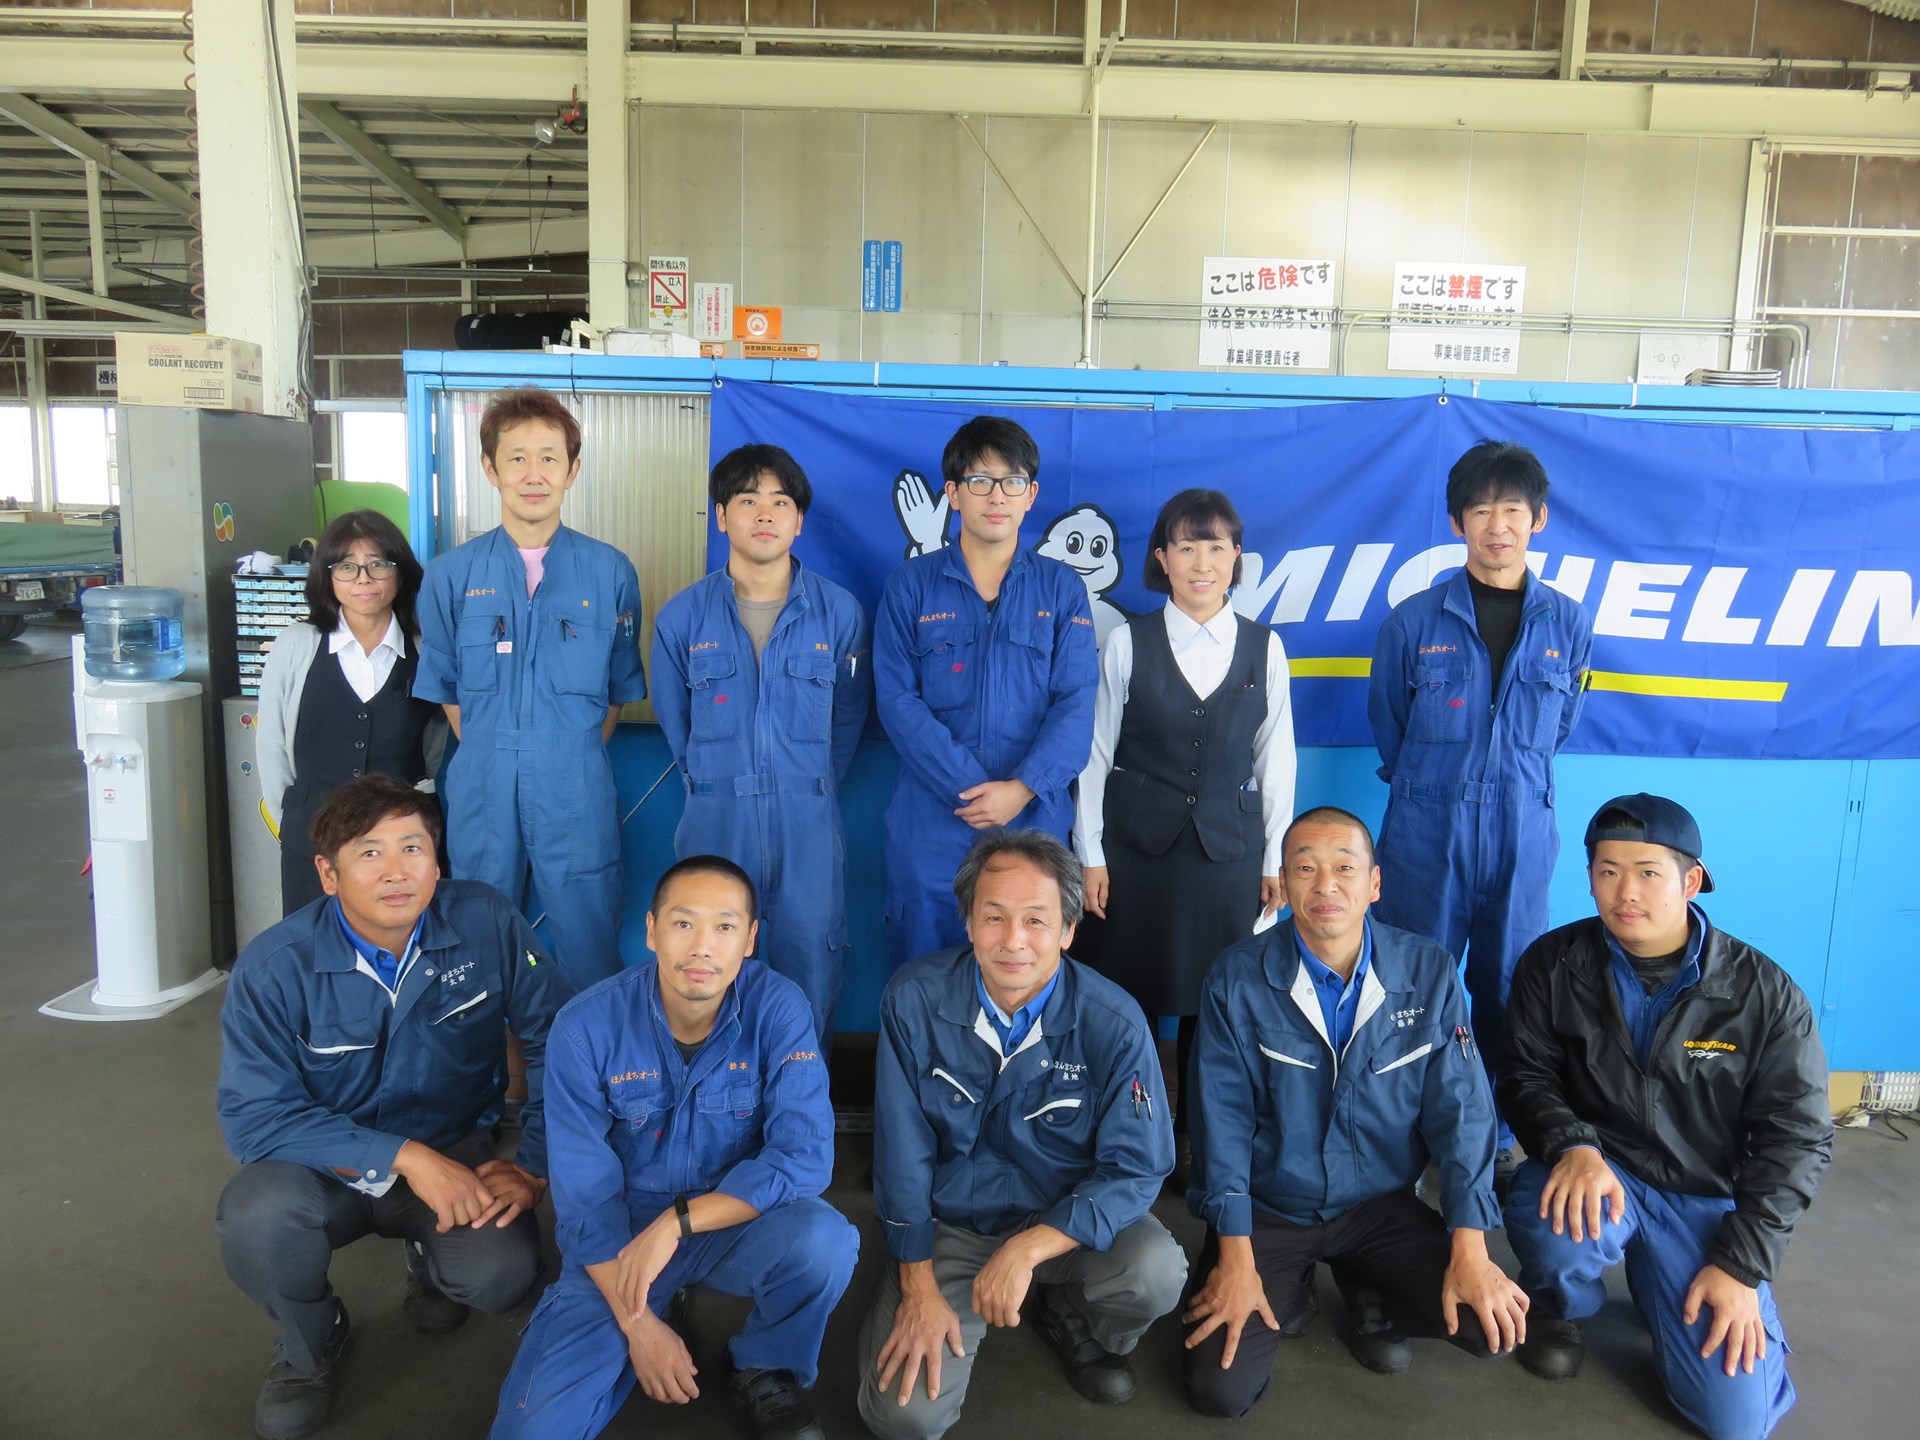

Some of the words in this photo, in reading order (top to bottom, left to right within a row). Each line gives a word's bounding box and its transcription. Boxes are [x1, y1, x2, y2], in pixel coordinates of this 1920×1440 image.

[650, 260, 686, 270] 関係者以外
[668, 277, 681, 286] 立入
[1210, 262, 1330, 295] ここは危険です
[1400, 274, 1519, 300] ここは禁煙です
[655, 295, 669, 304] 禁止
[1226, 349, 1300, 366] 事業場管理責任者
[1433, 344, 1511, 363] 事業場管理責任者
[148, 358, 183, 368] COOLANT
[184, 360, 224, 369] RECOVERY
[1683, 1040, 1736, 1052] GOODYEAR
[610, 1069, 659, 1085] ほんまちオート
